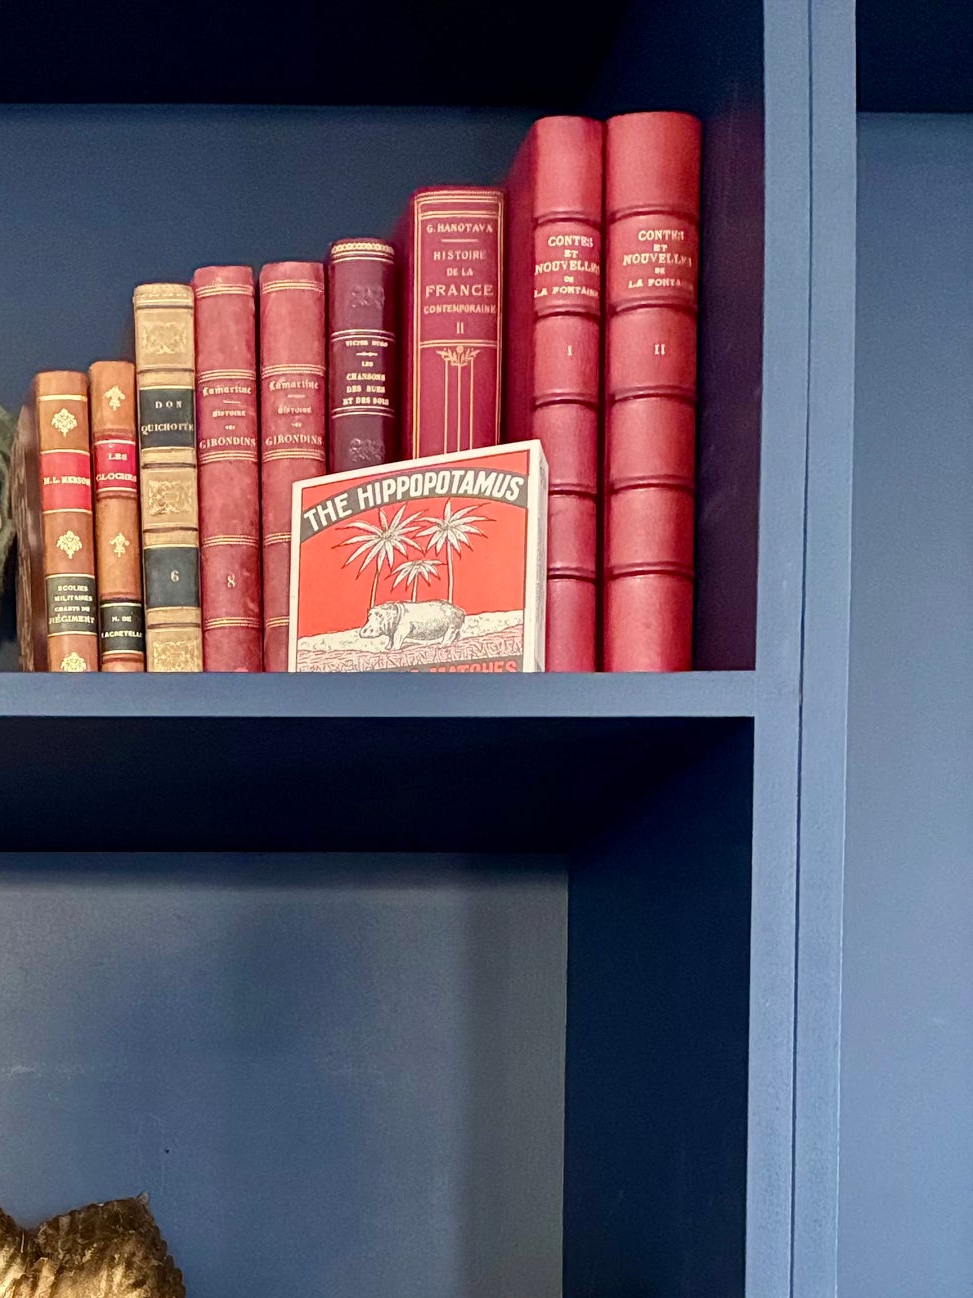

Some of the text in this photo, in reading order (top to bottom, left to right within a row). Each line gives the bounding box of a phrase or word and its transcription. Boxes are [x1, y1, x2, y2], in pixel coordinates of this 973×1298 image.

[638, 230, 684, 241] CONTES
[548, 235, 594, 248] CONTES
[653, 243, 668, 252] ET
[433, 250, 487, 261] HISTOIRE
[564, 249, 578, 258] ET
[447, 267, 473, 276] DE LA
[534, 260, 600, 276] NOUVELLES
[628, 278, 643, 289] LA
[425, 284, 494, 298] FRANCE
[534, 288, 548, 298] LA
[424, 304, 497, 315] CONTEMPORAINE
[456, 322, 464, 334] II
[655, 345, 665, 355] II
[346, 385, 362, 393] DES
[155, 401, 182, 409] DON
[199, 436, 256, 449] GIRONDINS
[265, 434, 322, 446] GIRONDINS
[303, 470, 524, 532] THE HIPPOPOTAMUS
[170, 571, 179, 582] 6
[227, 574, 236, 588] 8
